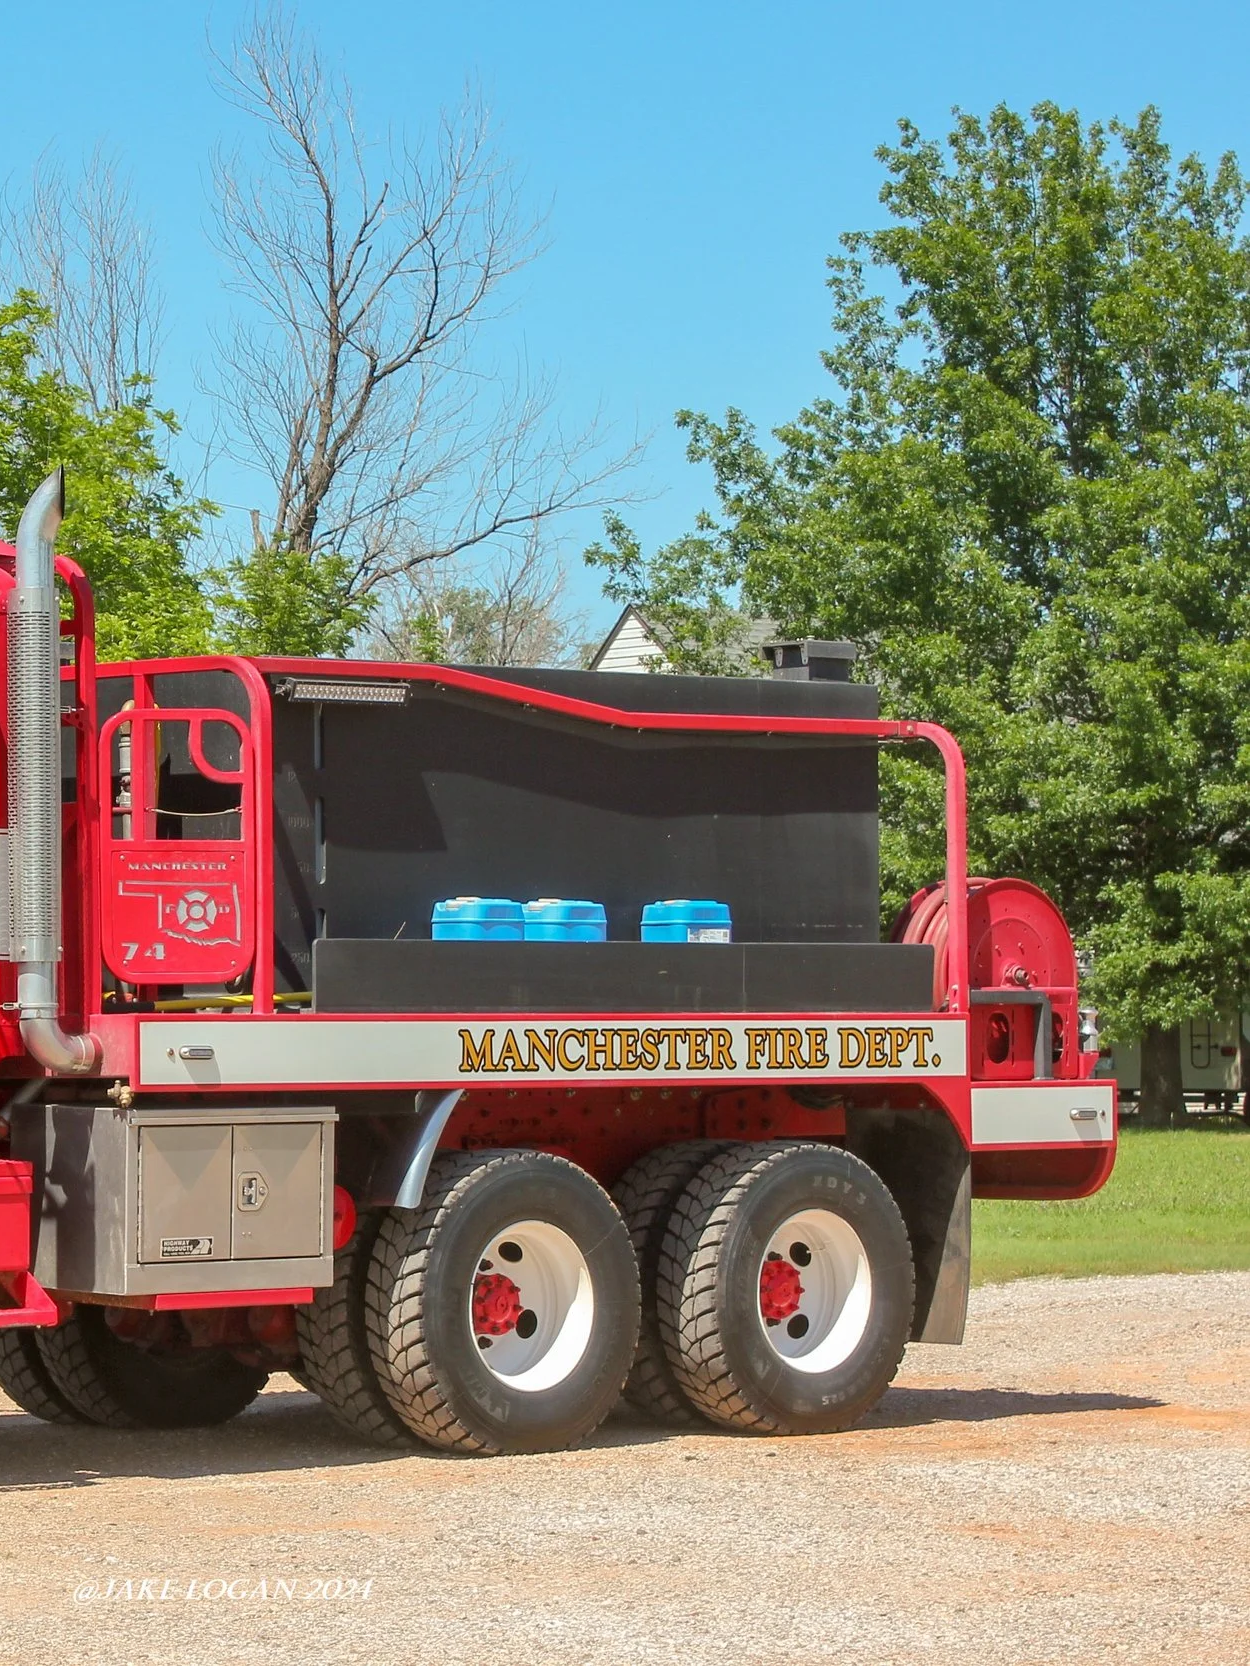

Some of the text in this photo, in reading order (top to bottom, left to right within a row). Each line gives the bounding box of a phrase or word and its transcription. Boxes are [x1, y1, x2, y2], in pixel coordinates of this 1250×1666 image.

[128, 862, 227, 871] MANCHESTER
[121, 942, 167, 961] 74
[458, 1026, 942, 1073] MANCHESTER FIRE DEPT.
